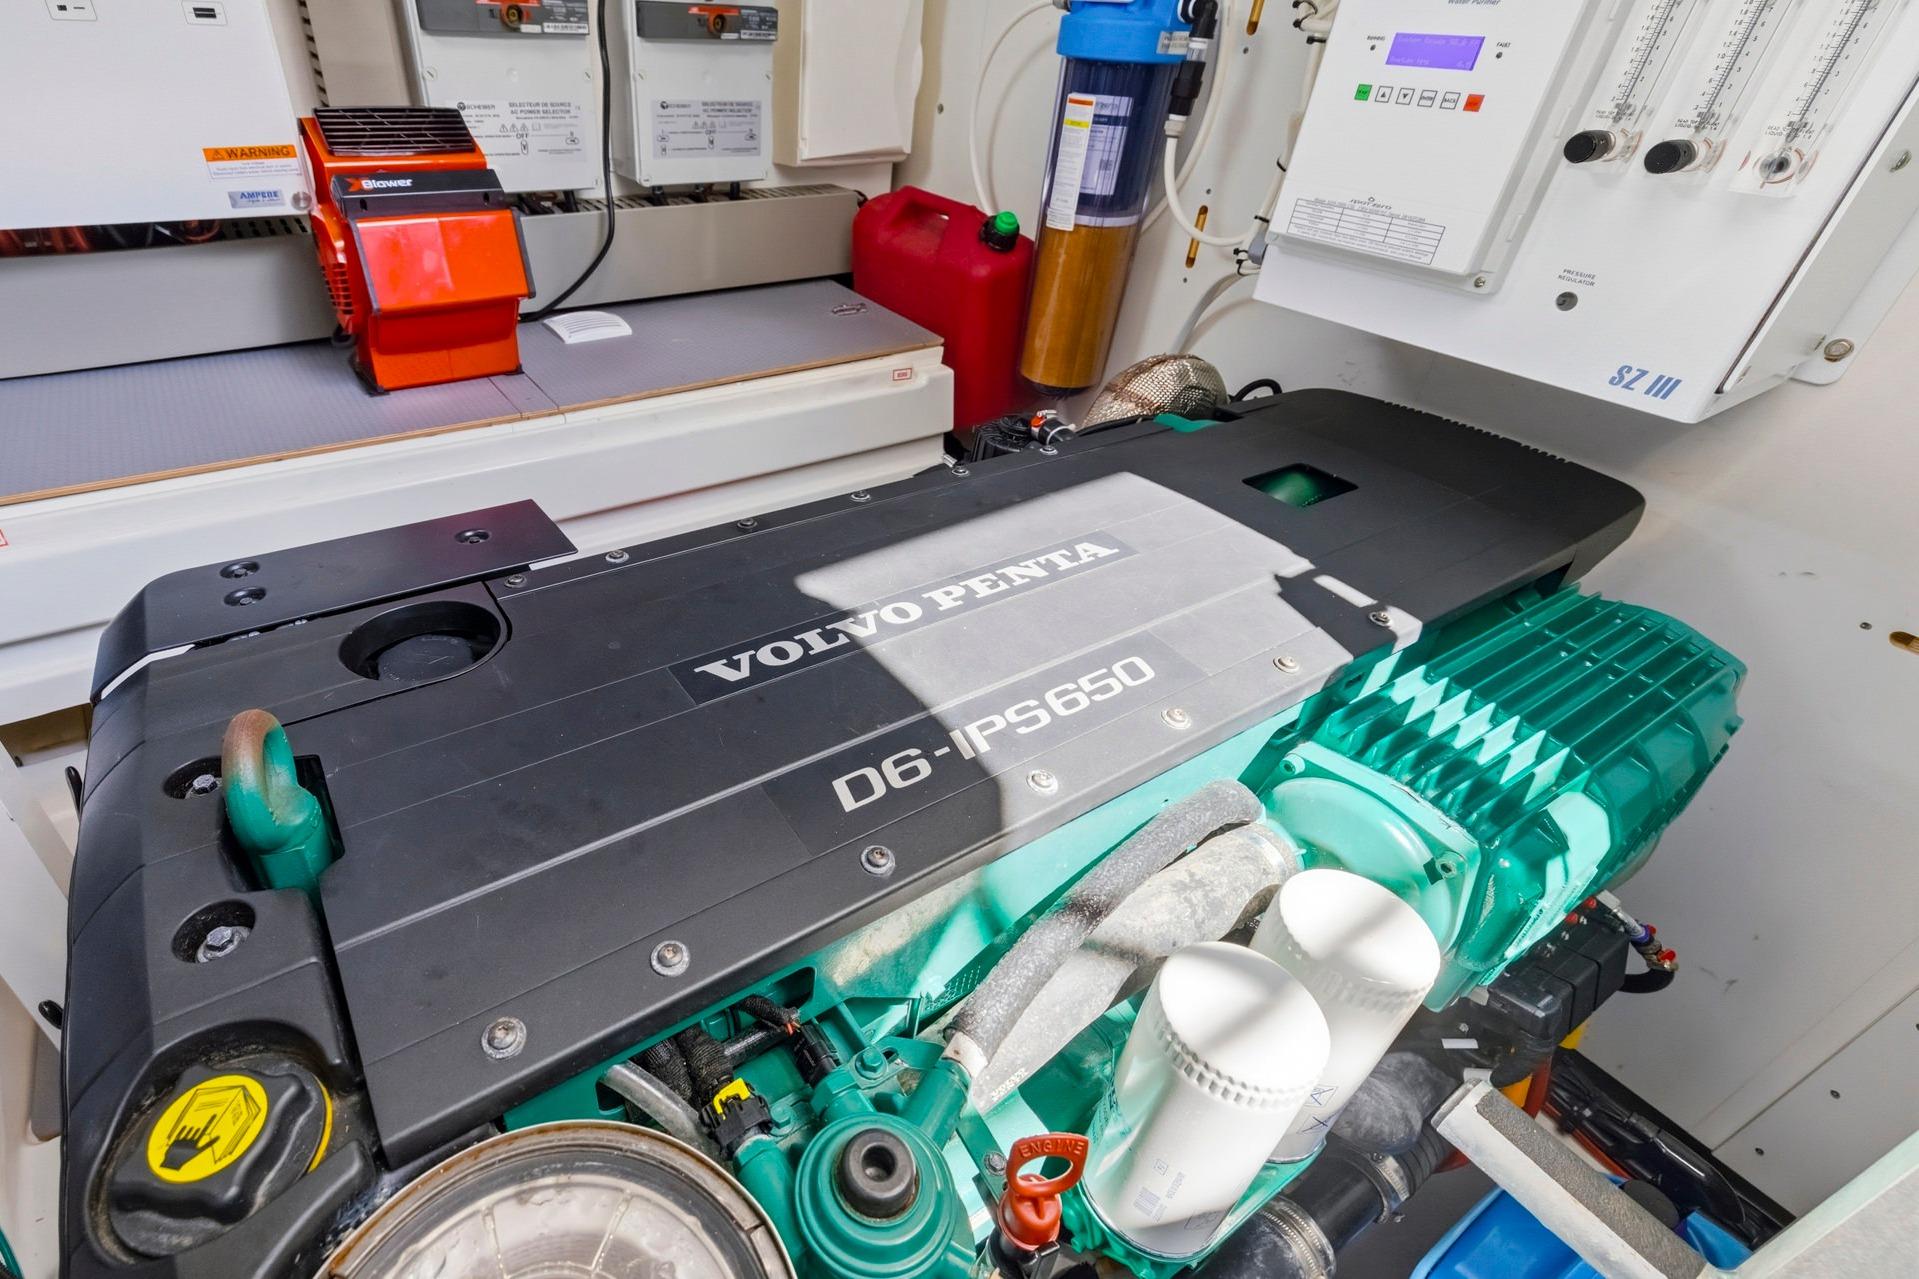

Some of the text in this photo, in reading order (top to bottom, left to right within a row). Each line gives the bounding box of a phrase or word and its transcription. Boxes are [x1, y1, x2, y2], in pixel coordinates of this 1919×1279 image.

[225, 146, 291, 160] WARNING
[1558, 274, 1596, 287] REGULATOR
[1563, 268, 1596, 280] PRESSURE
[1608, 365, 1682, 400] SZ III
[694, 541, 1120, 682] VOLVO PENTA
[831, 655, 1156, 813] D6-IPS650
[1019, 1138, 1086, 1158] ENGINE
